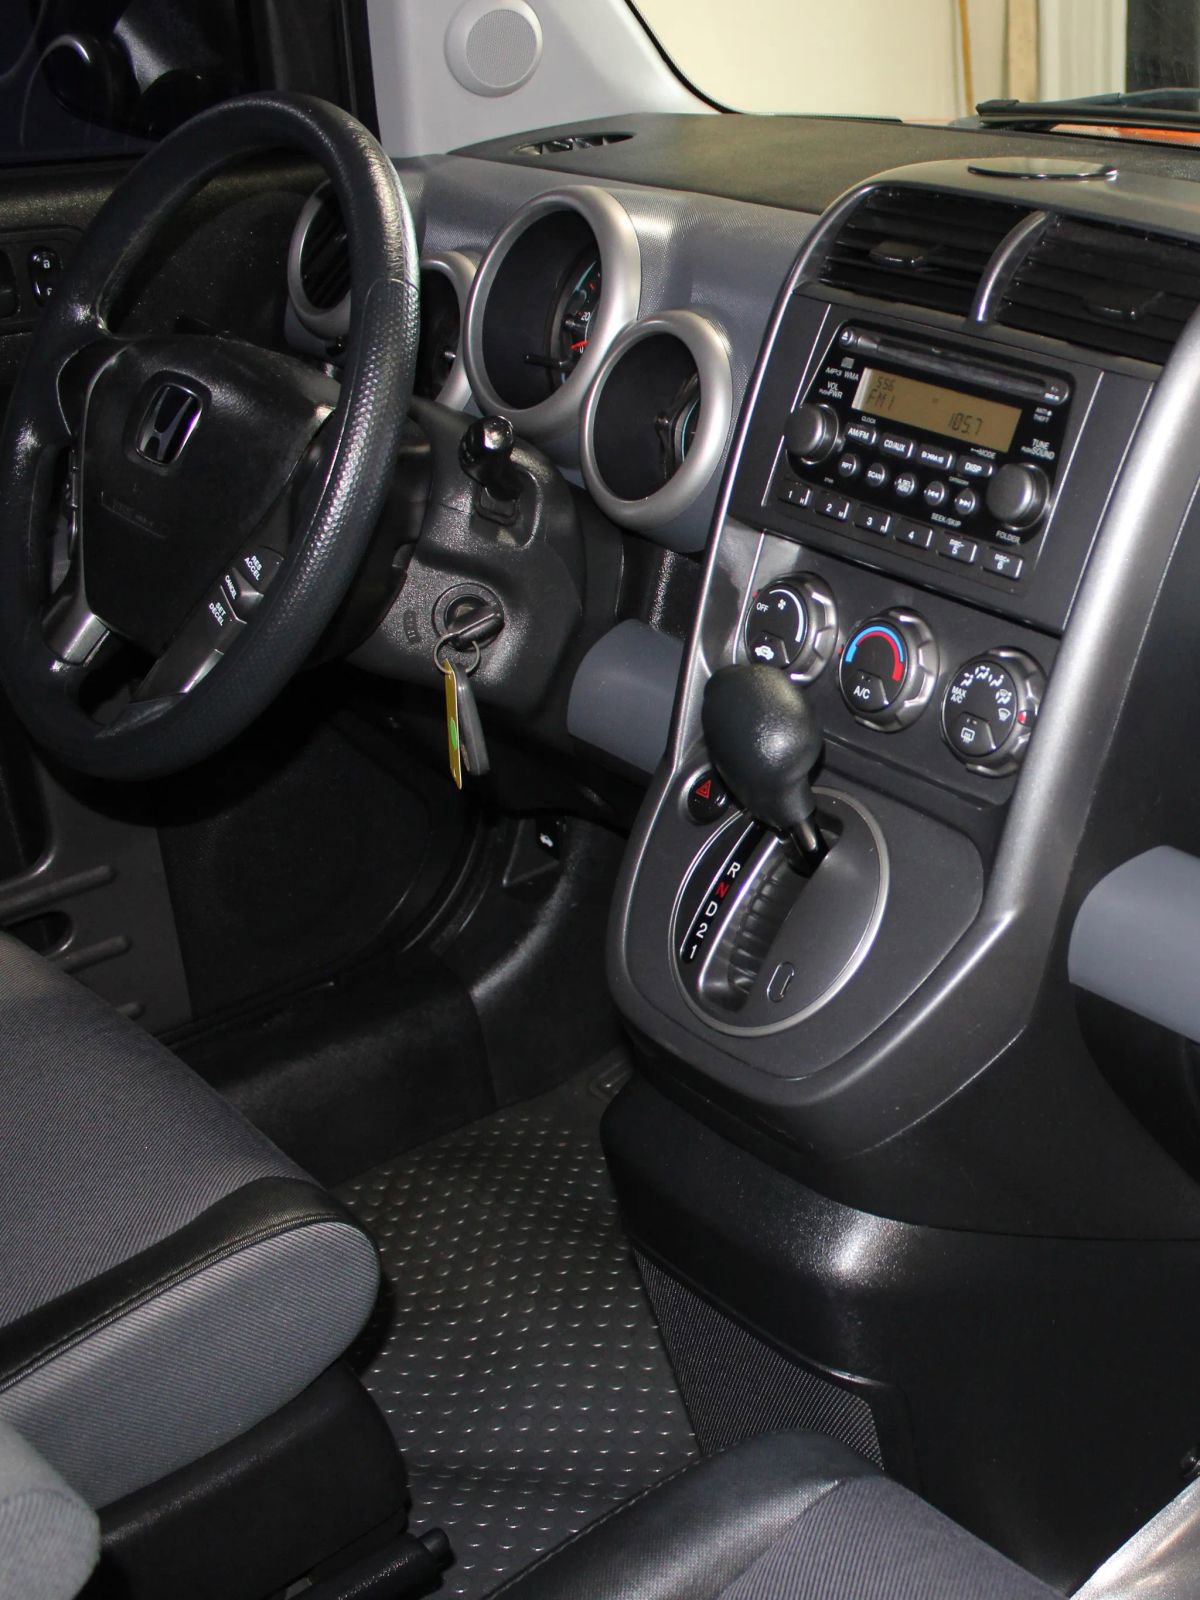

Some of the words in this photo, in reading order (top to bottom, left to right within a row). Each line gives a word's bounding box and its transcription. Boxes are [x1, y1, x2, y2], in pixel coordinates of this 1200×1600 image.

[581, 311, 591, 321] 20
[825, 367, 842, 377] MP3
[844, 370, 859, 380] WMA
[827, 381, 839, 391] VOL
[847, 427, 870, 440] AM/FM
[884, 439, 906, 452] CD/AUX
[1032, 438, 1050, 450] TUNE
[1031, 446, 1055, 459] SOUND
[965, 461, 983, 473] DISP
[788, 490, 793, 499] 1
[825, 503, 833, 513] 2
[866, 517, 873, 526] 3
[908, 531, 915, 540] 4
[995, 530, 1020, 544] FOLDER
[951, 546, 958, 555] 5
[244, 557, 261, 581] ACCEL
[251, 555, 262, 570] RES
[997, 561, 1004, 570] 6
[225, 575, 236, 599] CANCEL
[209, 602, 224, 626] DECEL
[215, 602, 226, 617] SET
[756, 602, 769, 613] OFF
[853, 685, 871, 700] A/C
[951, 685, 967, 698] MAX
[950, 694, 963, 704] A/C
[727, 861, 741, 878] R
[714, 881, 730, 898] N
[705, 900, 718, 917] D
[696, 922, 708, 939] 2
[690, 944, 698, 959] 1
